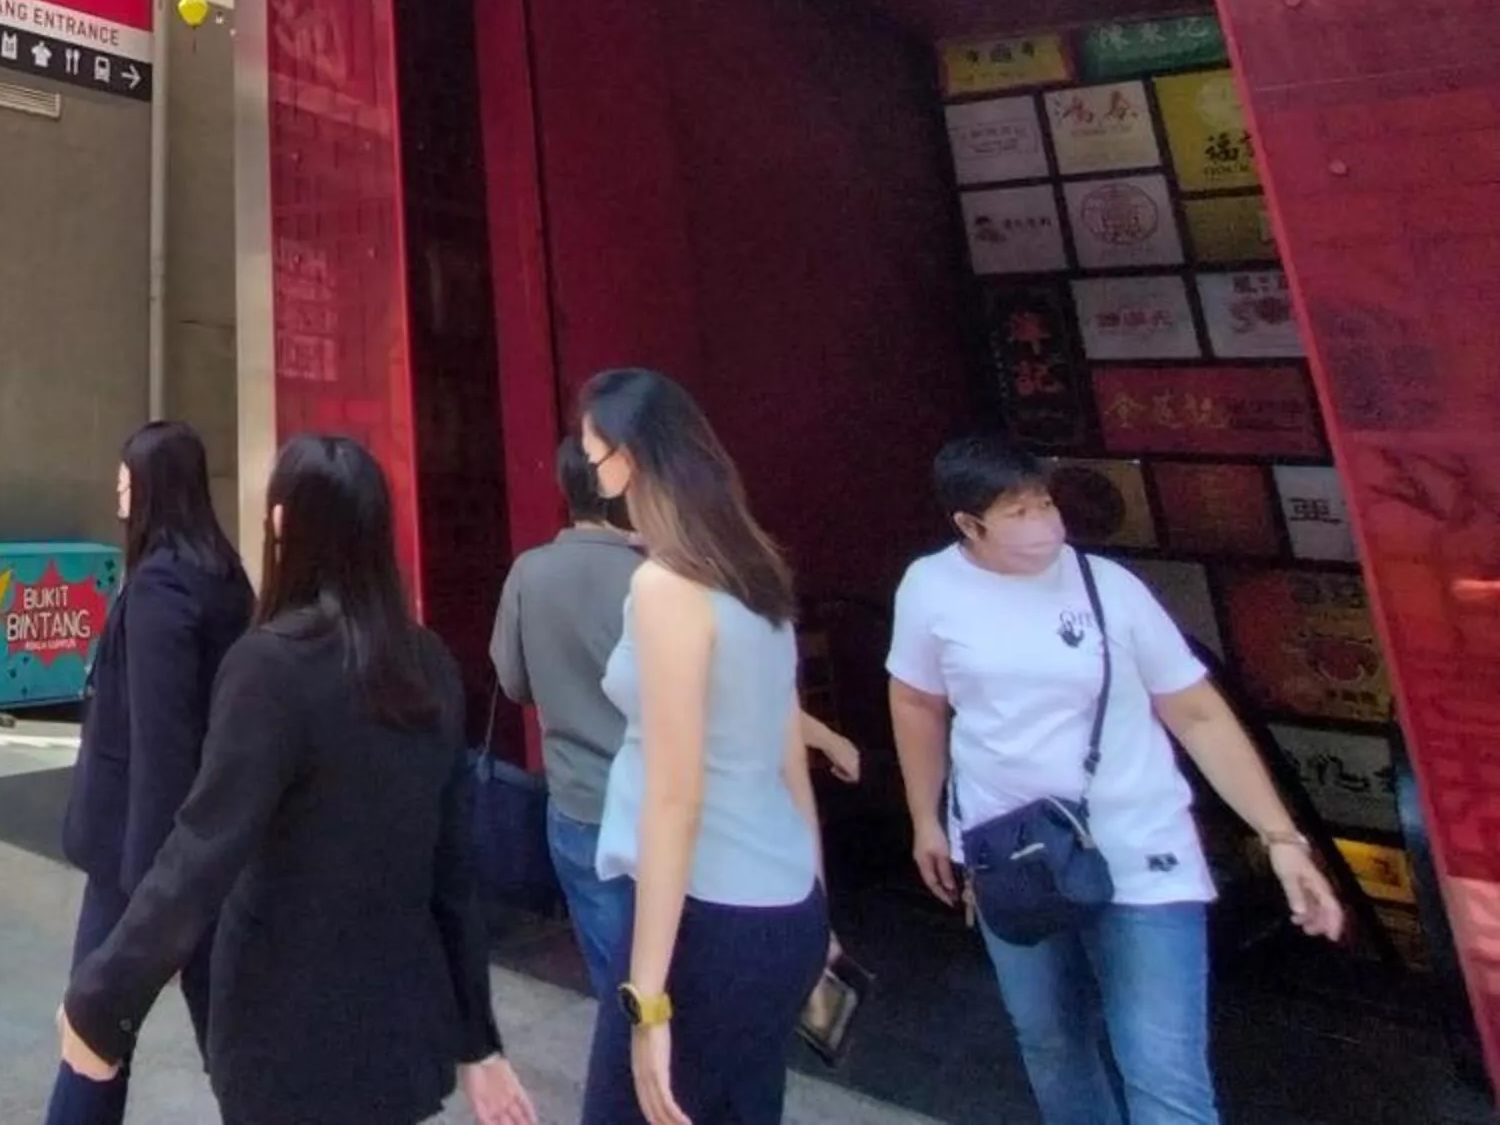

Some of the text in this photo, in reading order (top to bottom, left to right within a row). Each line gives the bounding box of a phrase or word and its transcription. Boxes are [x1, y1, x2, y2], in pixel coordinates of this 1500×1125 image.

[32, 7, 120, 47] ENTRANCE
[23, 584, 69, 610] BUKIT
[7, 609, 91, 642] BINTANG
